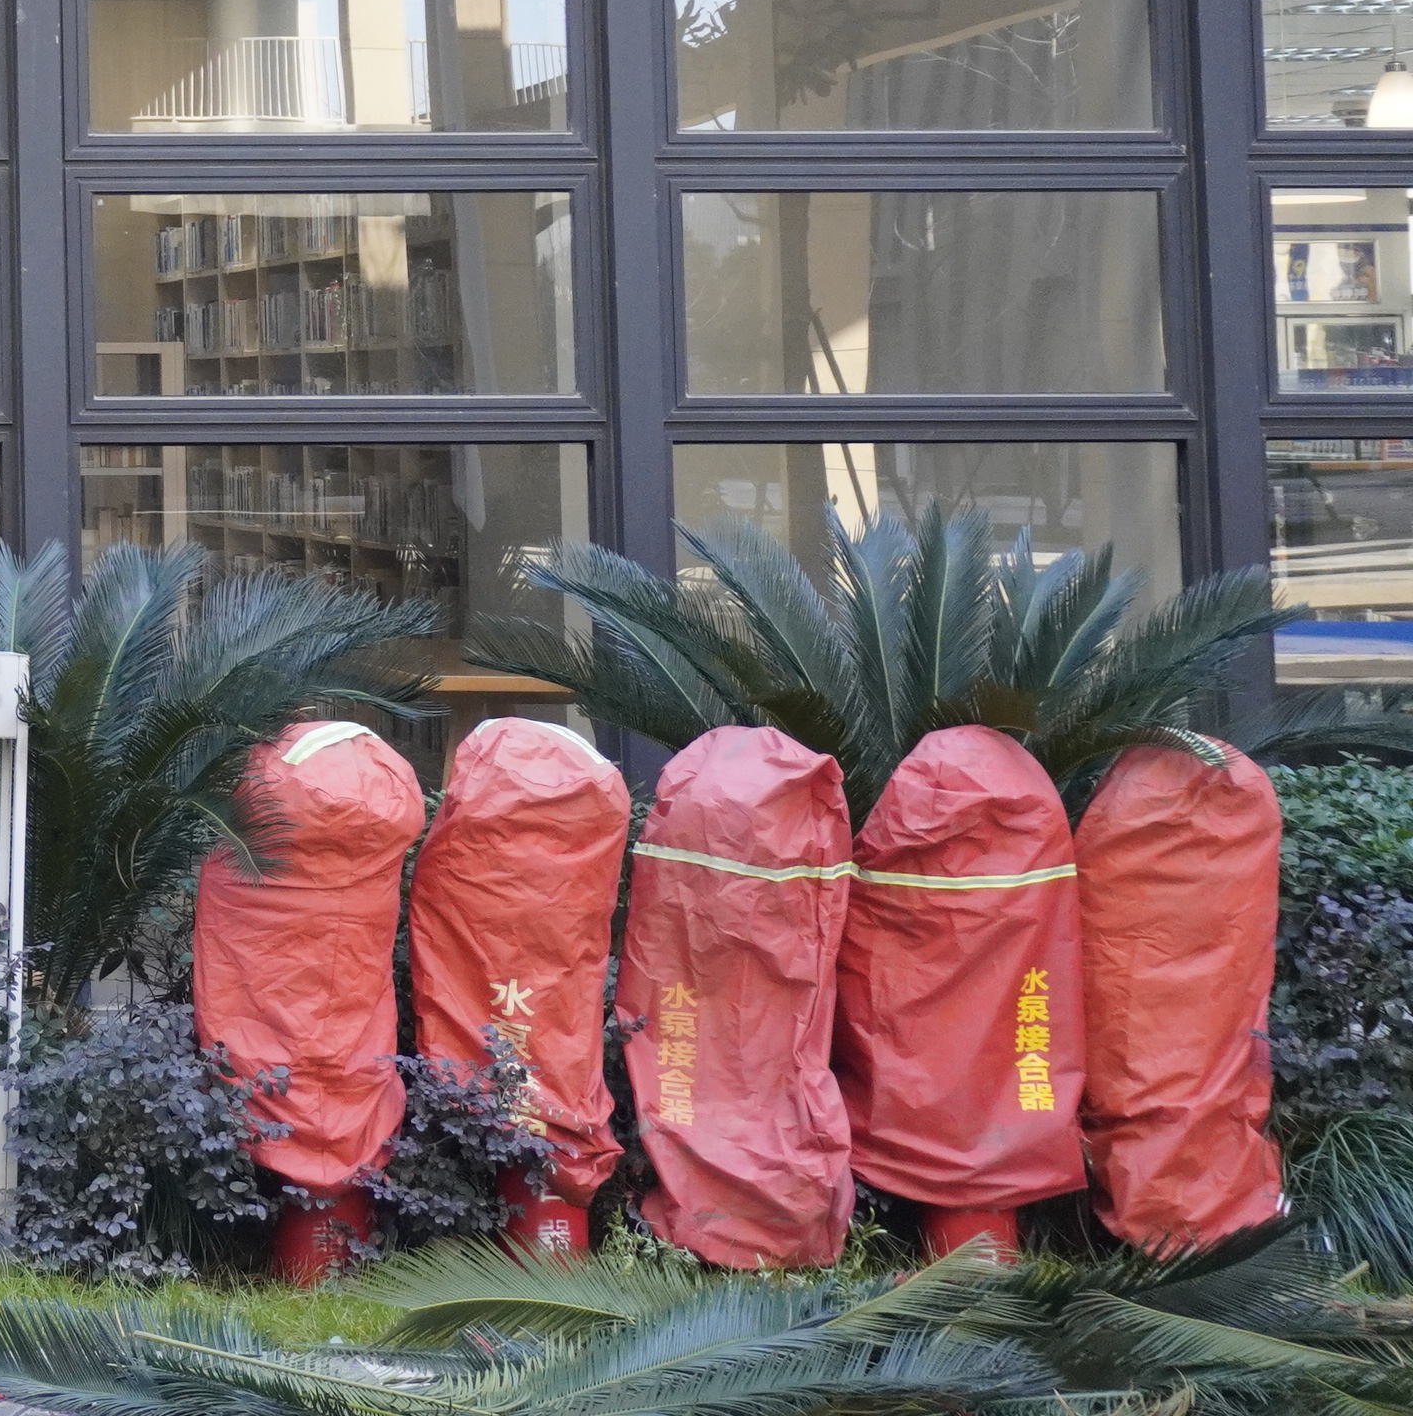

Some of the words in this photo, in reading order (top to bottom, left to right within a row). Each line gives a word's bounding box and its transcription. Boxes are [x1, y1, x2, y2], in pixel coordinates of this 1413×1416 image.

[657, 982, 698, 1126] 水泵接合器
[1015, 967, 1055, 1111] 水泵接合器
